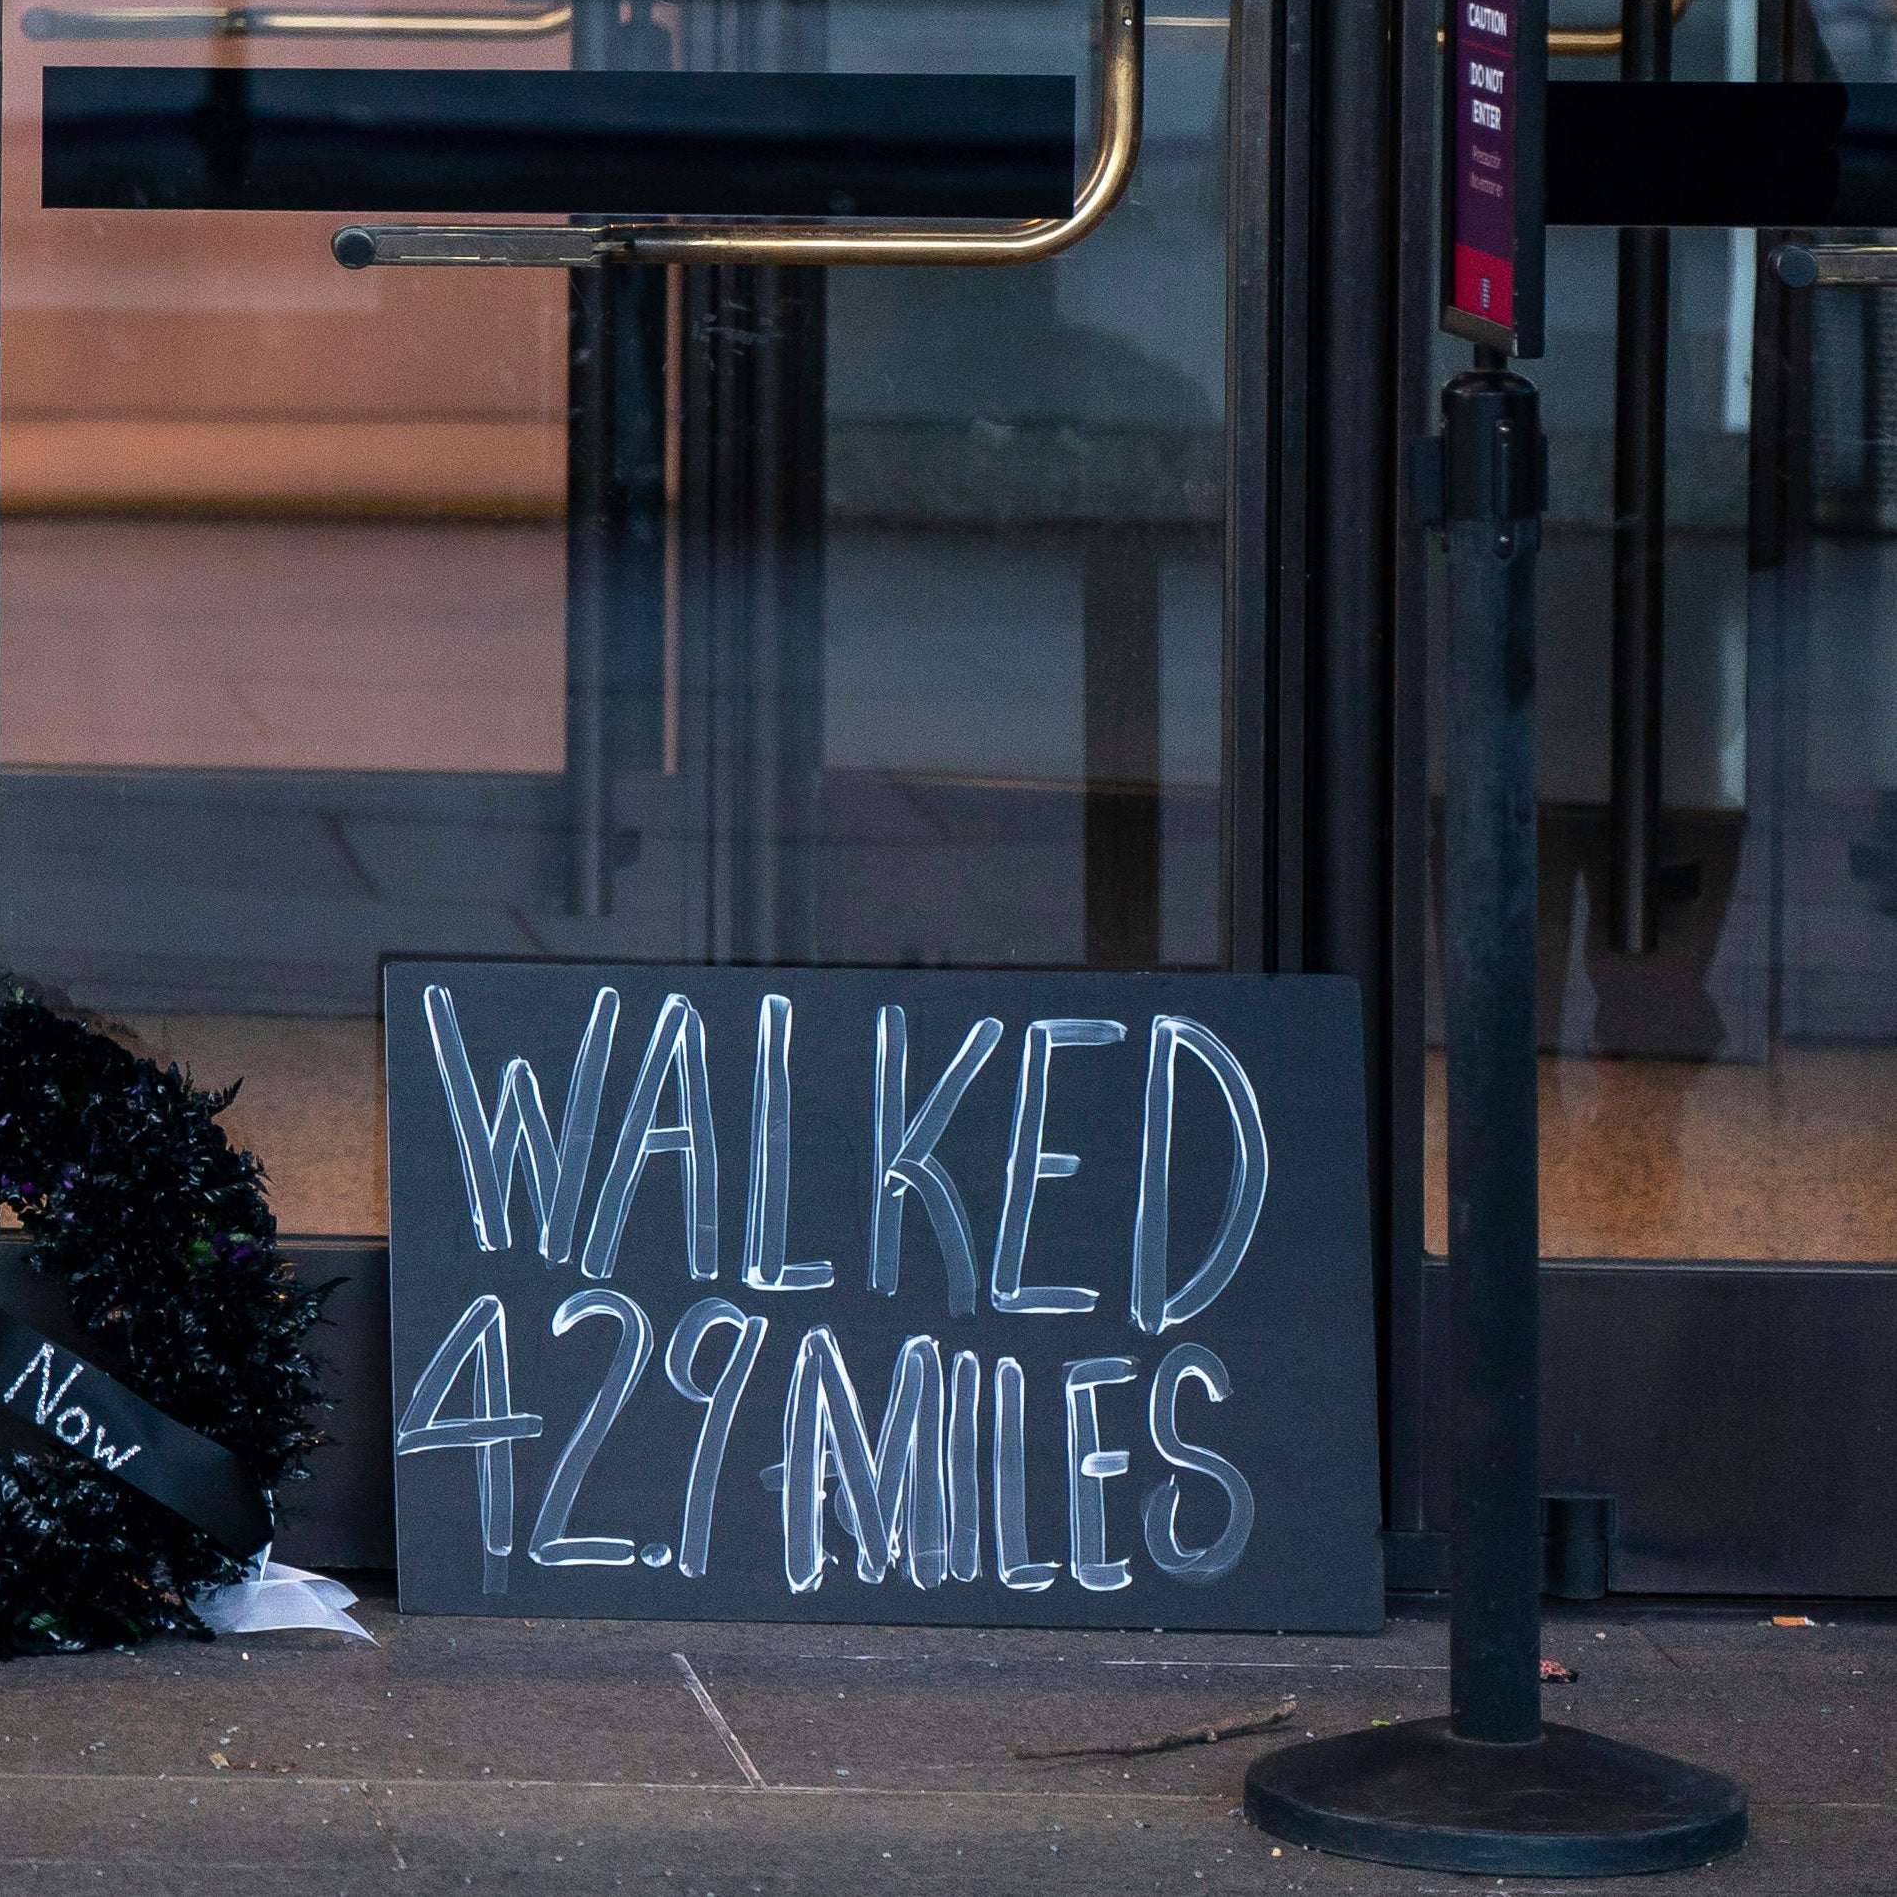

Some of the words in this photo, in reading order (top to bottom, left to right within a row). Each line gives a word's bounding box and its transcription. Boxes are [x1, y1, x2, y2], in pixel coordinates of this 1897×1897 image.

[1467, 2, 1507, 37] CAUTION
[1469, 62, 1485, 87] DO
[1485, 67, 1504, 94] NOT
[1471, 99, 1502, 131] ENTER
[423, 984, 1269, 1335] WALKED
[4, 1343, 142, 1472] Now
[396, 1289, 769, 1594] 42.9
[780, 1324, 1255, 1594] MILES
